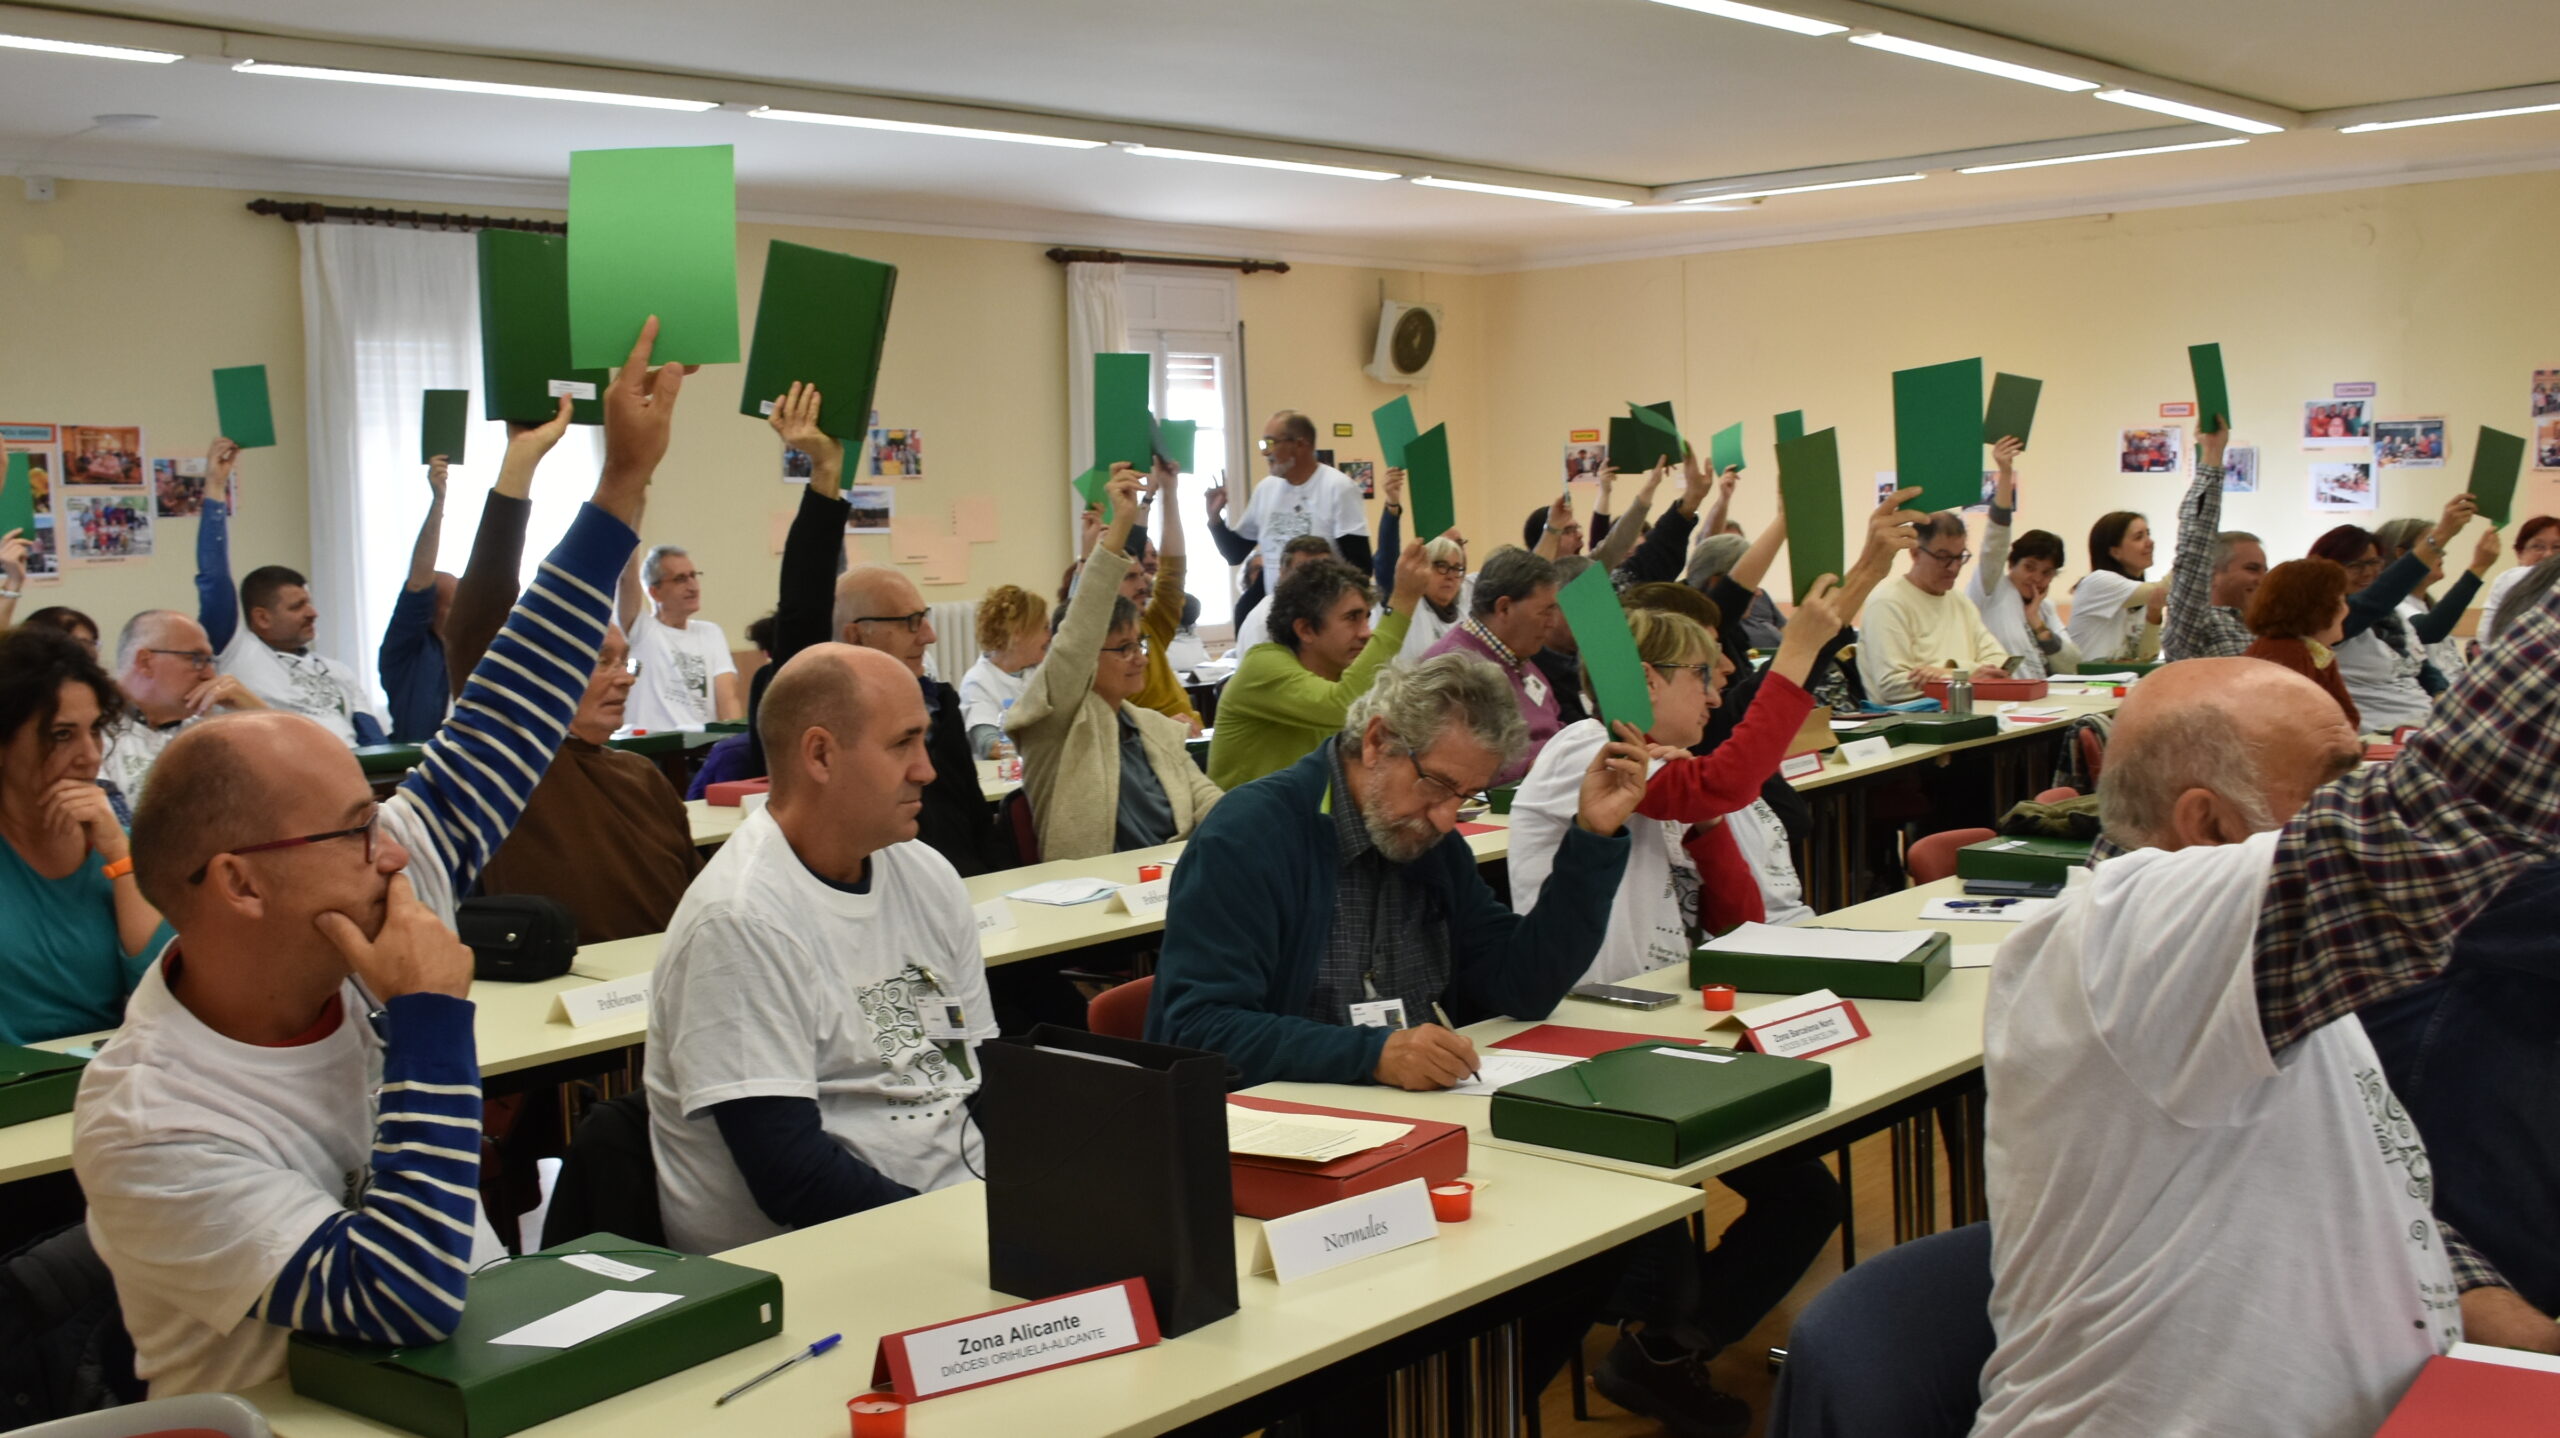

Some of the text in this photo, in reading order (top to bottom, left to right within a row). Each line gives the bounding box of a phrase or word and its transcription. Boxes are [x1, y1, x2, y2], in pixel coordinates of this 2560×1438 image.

[1323, 1214, 1389, 1252] Normales
[958, 1314, 1080, 1355] Zona Alicante
[992, 1328, 1106, 1365] ORIHUELA-ALICANTE
